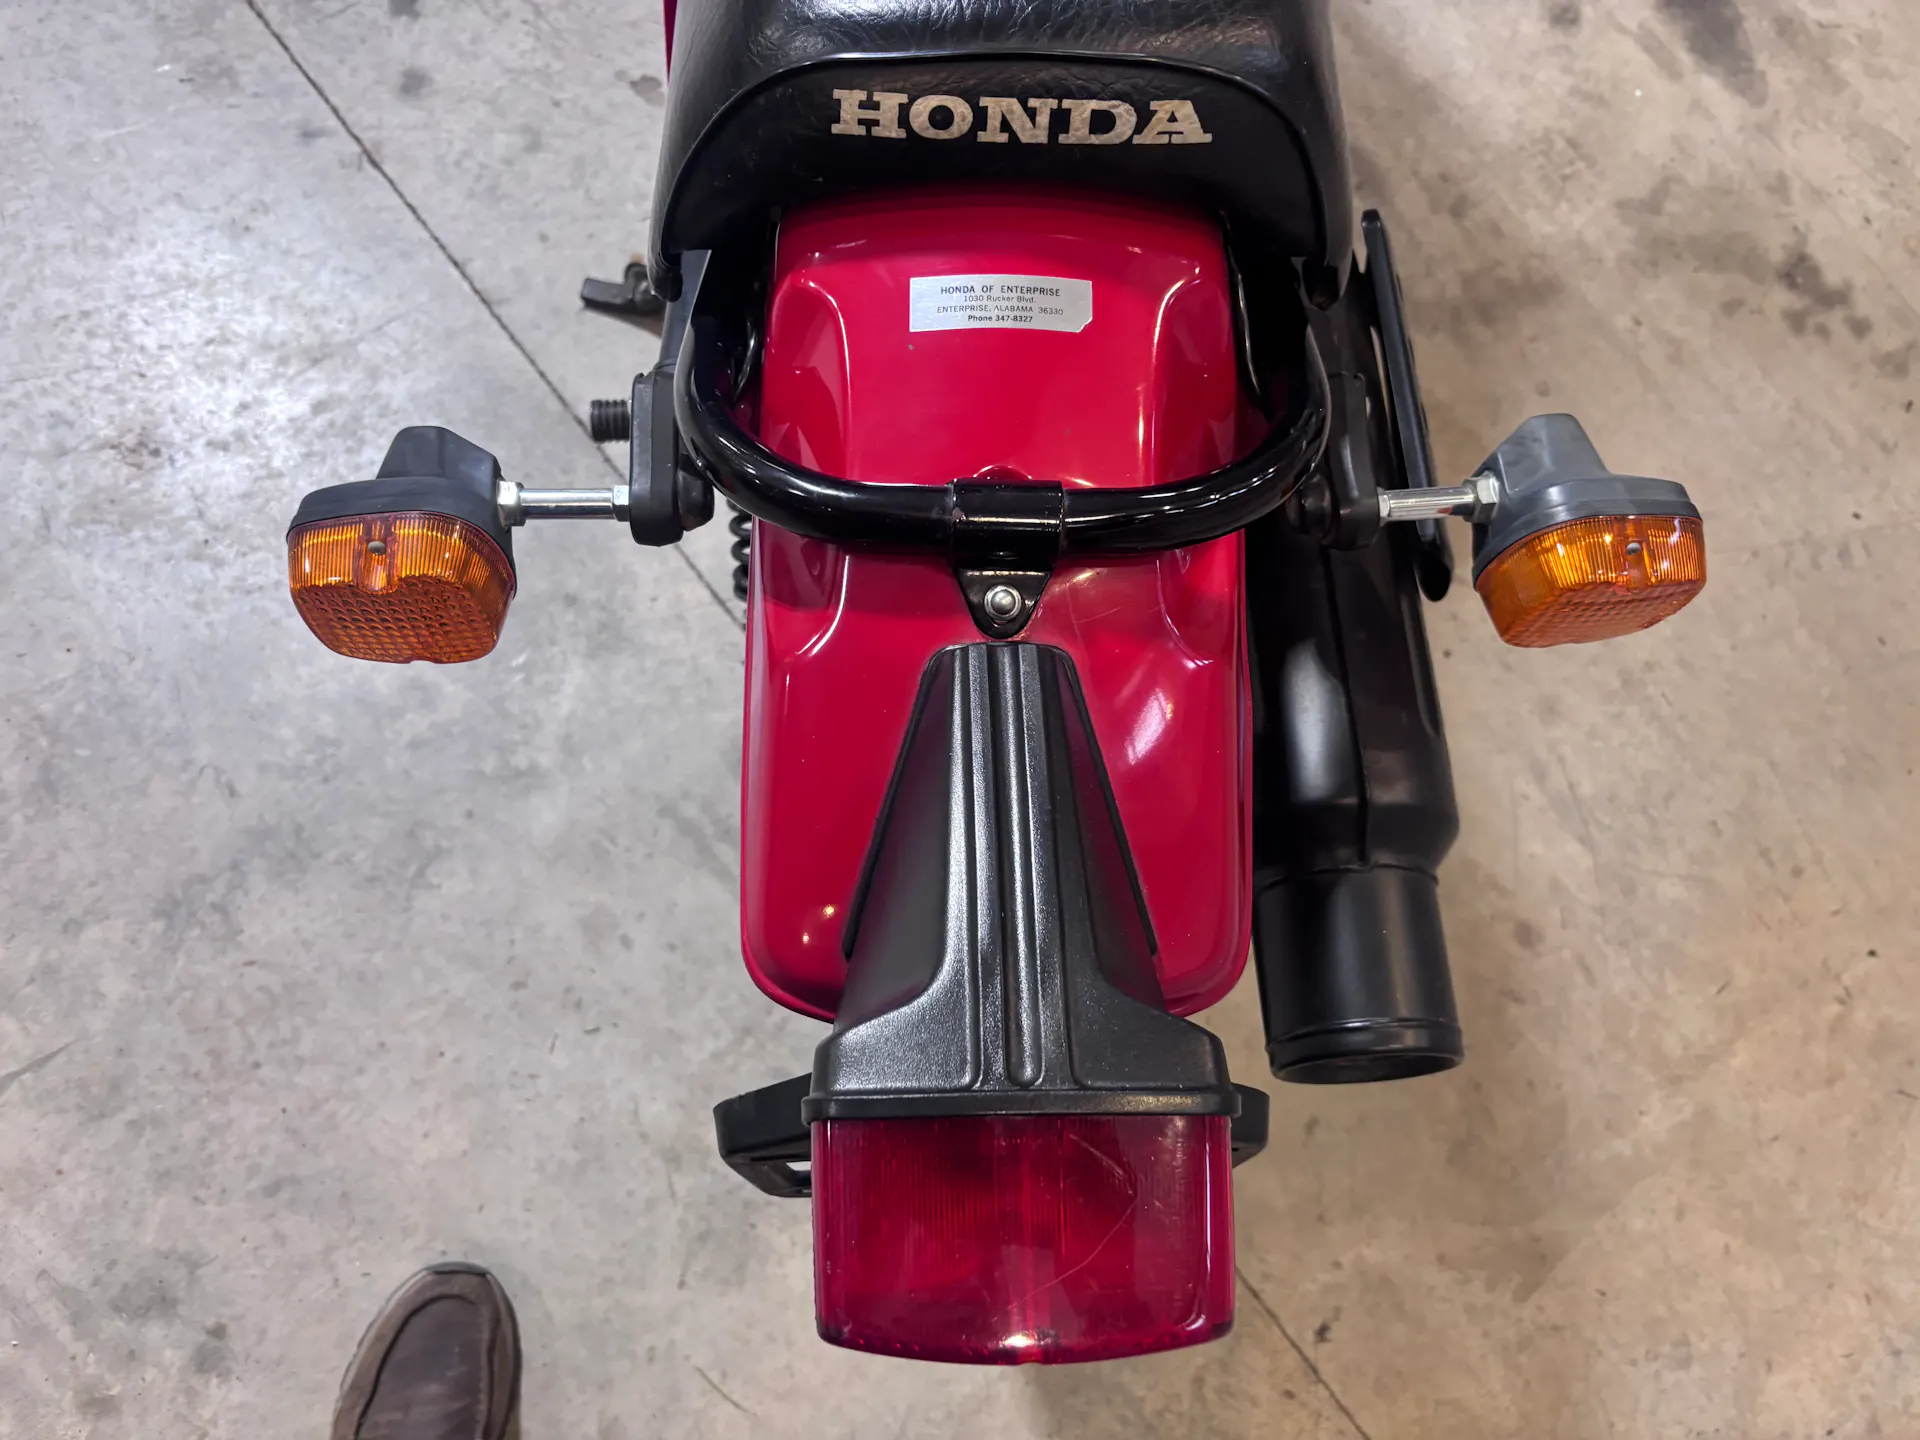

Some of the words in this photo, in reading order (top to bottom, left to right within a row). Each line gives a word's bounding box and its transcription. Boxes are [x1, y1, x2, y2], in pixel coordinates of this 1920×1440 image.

[831, 88, 1213, 145] HONDA
[940, 286, 976, 295] HONDA
[981, 285, 994, 294] OF
[1000, 285, 1061, 297] ENTERPRISE
[963, 295, 984, 303] 1030
[986, 295, 1014, 303] Rucker
[1016, 295, 1037, 304] Blvd.
[993, 305, 1034, 313] ALABAMA
[1038, 307, 1064, 316] 36330
[967, 314, 993, 322] Phone
[995, 314, 1033, 323] 347-8327
